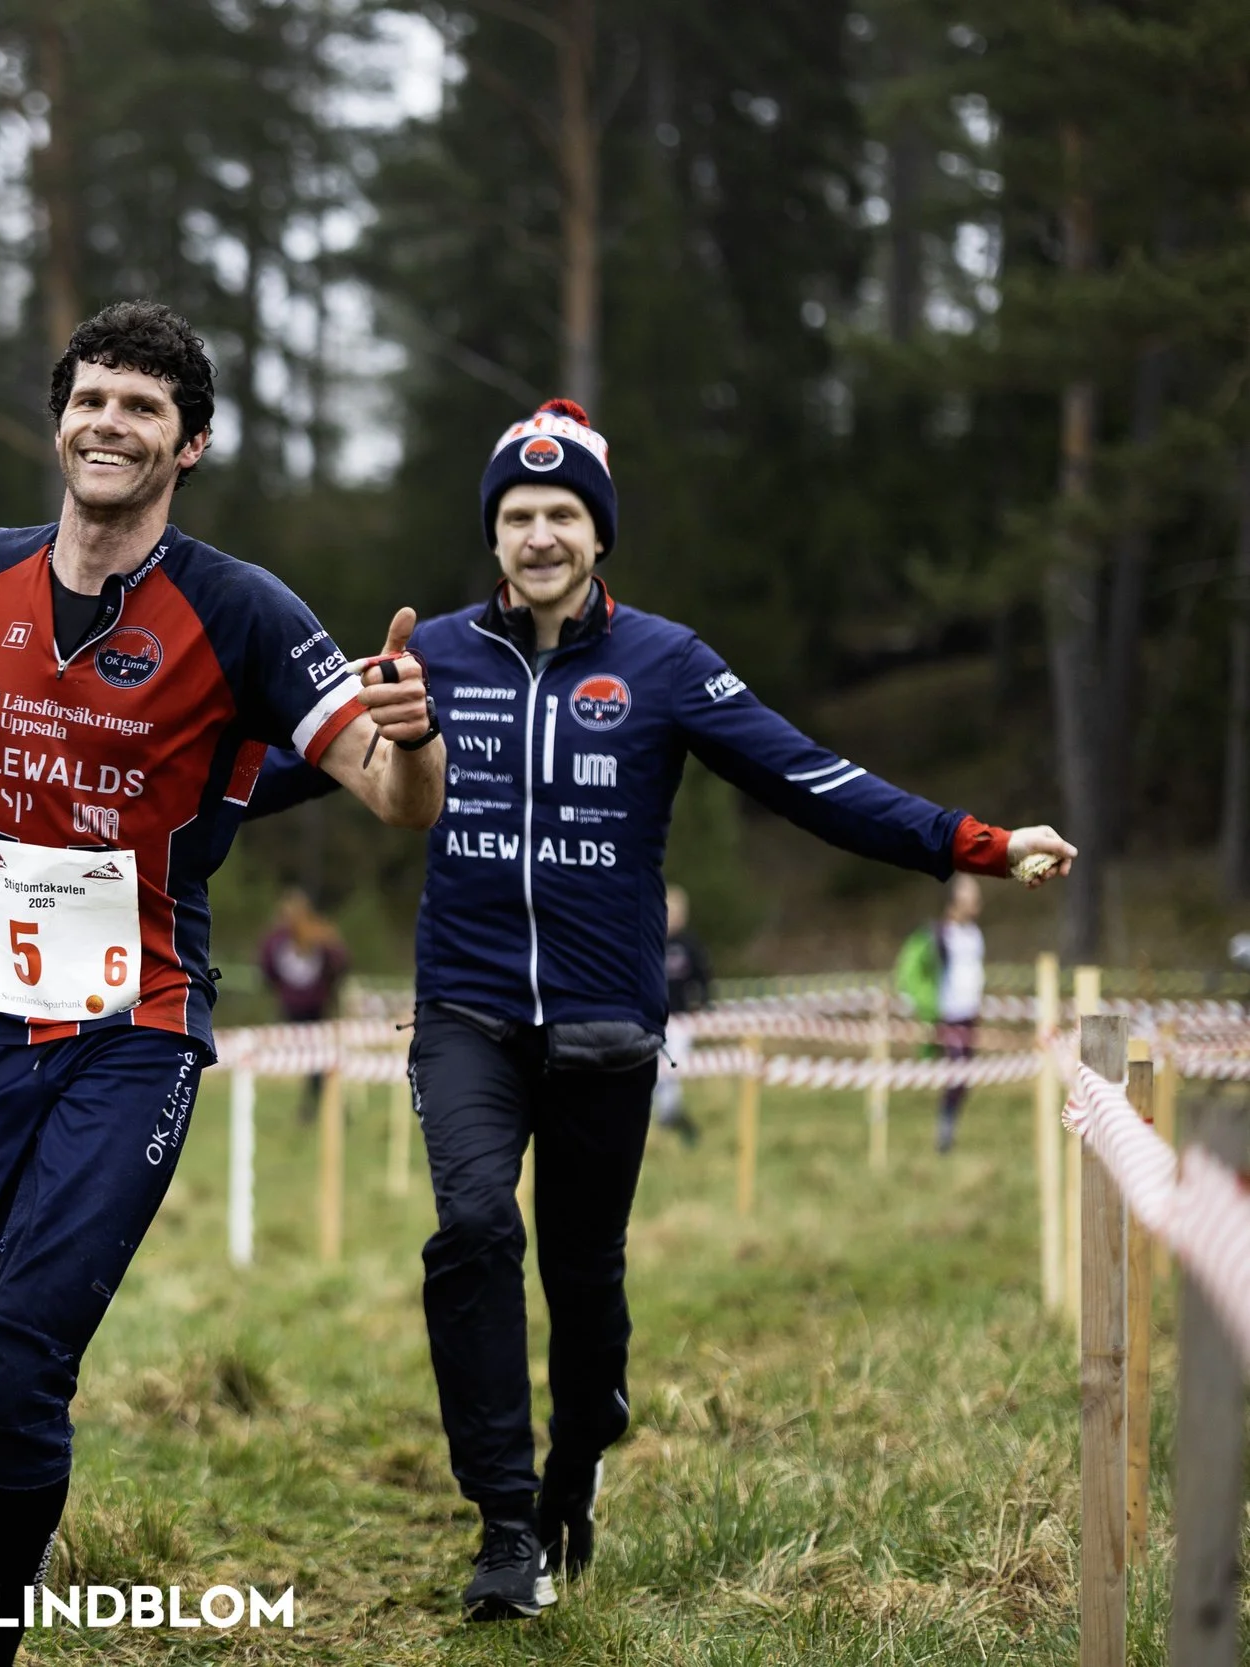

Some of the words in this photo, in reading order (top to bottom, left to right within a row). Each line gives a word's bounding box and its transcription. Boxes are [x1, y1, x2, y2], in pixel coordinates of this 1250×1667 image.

[128, 544, 169, 588] UPPSALA
[104, 656, 120, 666] OK
[122, 659, 149, 671] Linné
[453, 686, 517, 700] noname
[580, 700, 594, 711] OK
[0, 712, 68, 741] Uppsala
[2, 693, 155, 737] Länsförsäkringar
[573, 753, 618, 787] UMA
[72, 802, 120, 840] UMA
[4, 877, 86, 895] Stigtomtakavlen
[28, 897, 56, 908] 2025
[9, 919, 43, 987] 5
[103, 945, 128, 987] 6
[146, 1124, 171, 1165] OK
[162, 1051, 198, 1120] Linné
[170, 1086, 192, 1148] UPPSALA
